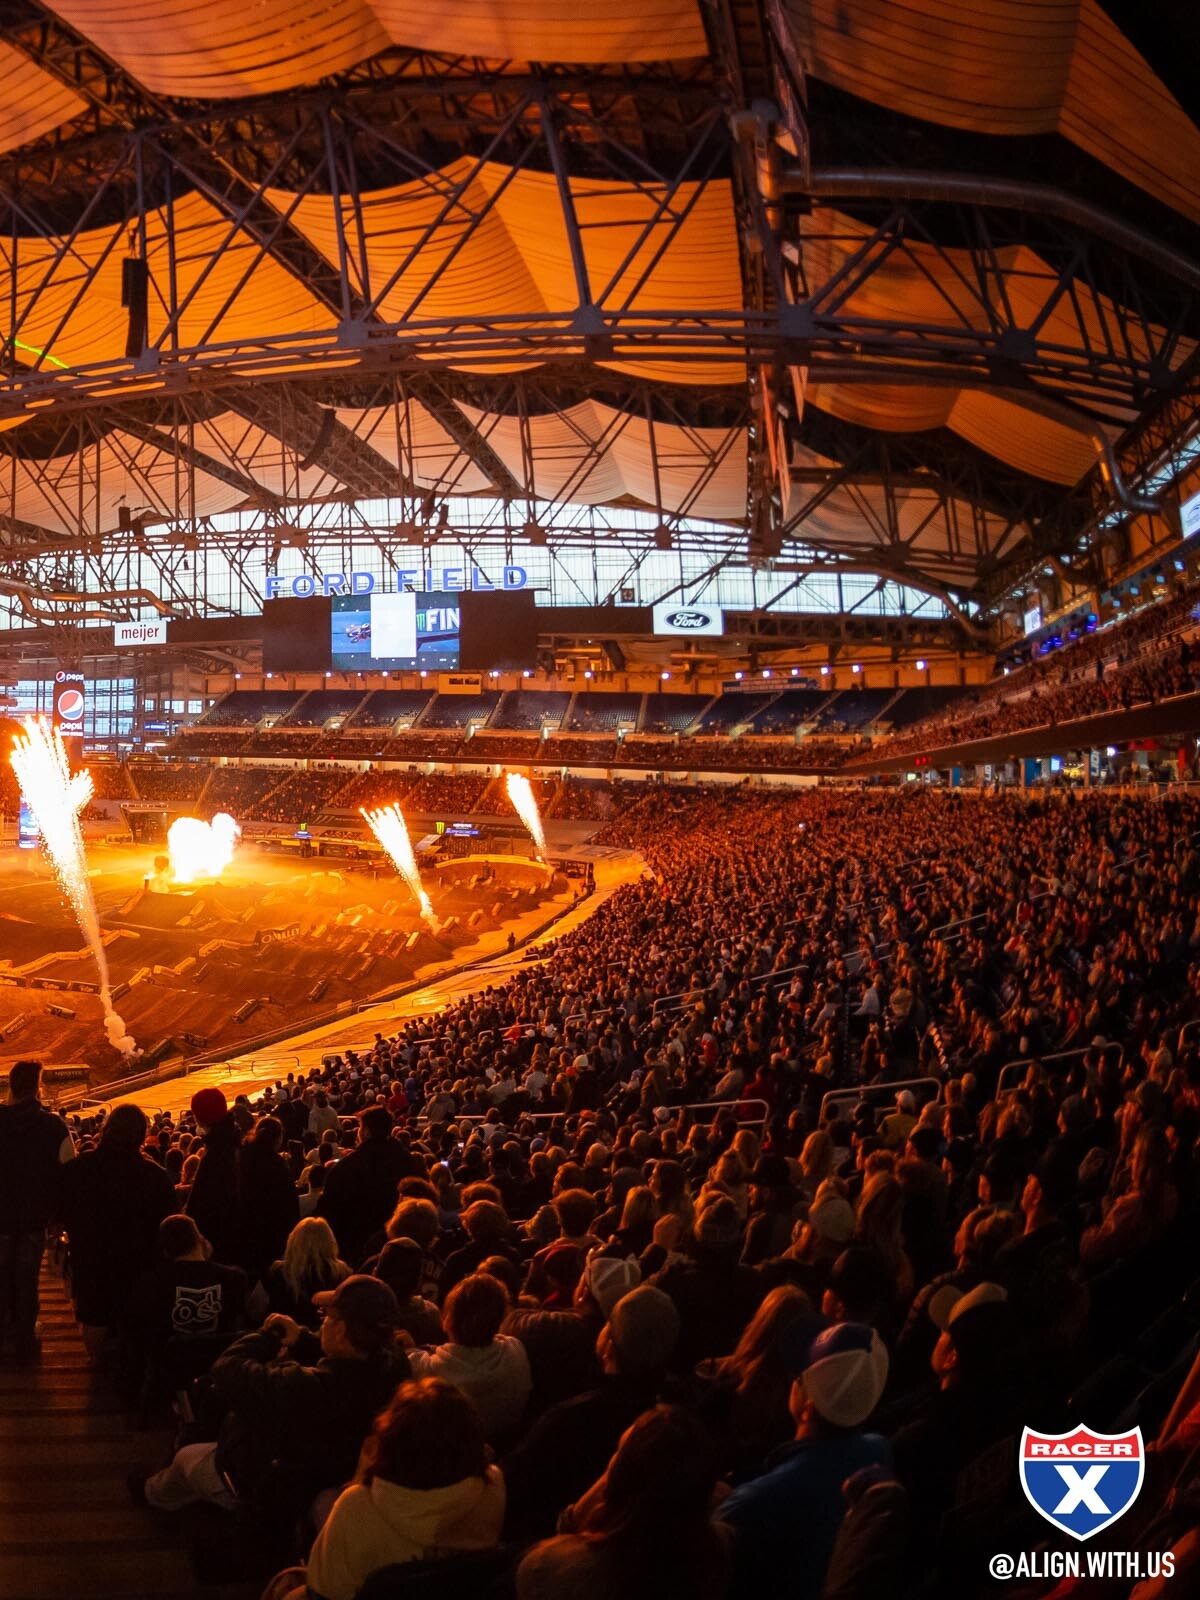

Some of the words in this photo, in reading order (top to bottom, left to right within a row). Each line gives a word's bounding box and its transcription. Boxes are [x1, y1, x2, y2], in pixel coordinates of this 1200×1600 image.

[264, 571, 376, 599] FORD
[397, 566, 529, 593] FIELD
[426, 608, 459, 632] FIN
[672, 612, 703, 628] Ford
[121, 624, 160, 641] meijer
[60, 722, 83, 732] pepsi
